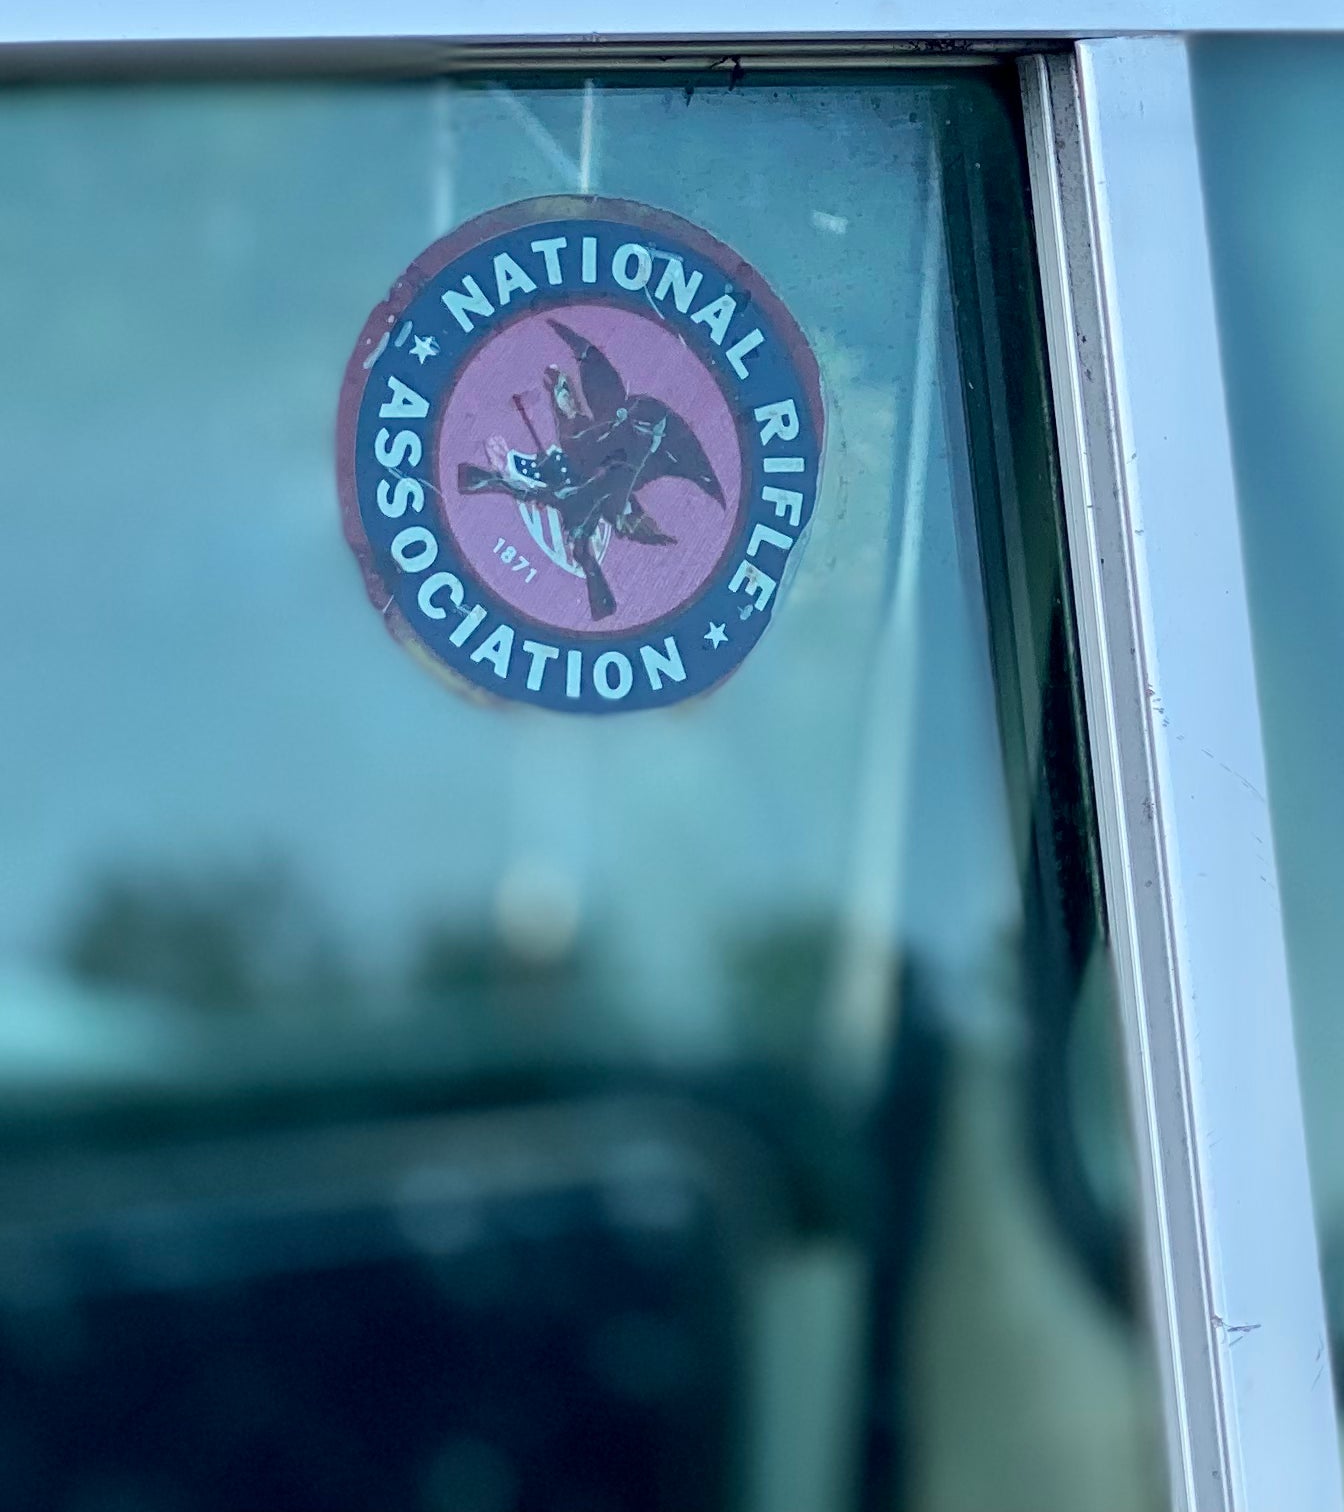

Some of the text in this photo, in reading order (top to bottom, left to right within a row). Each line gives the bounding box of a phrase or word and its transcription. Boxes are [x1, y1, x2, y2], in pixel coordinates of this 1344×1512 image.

[374, 375, 687, 700] ASSOCIATION
[441, 236, 805, 612] NATIONAL RIFLE
[493, 537, 538, 584] 1871
